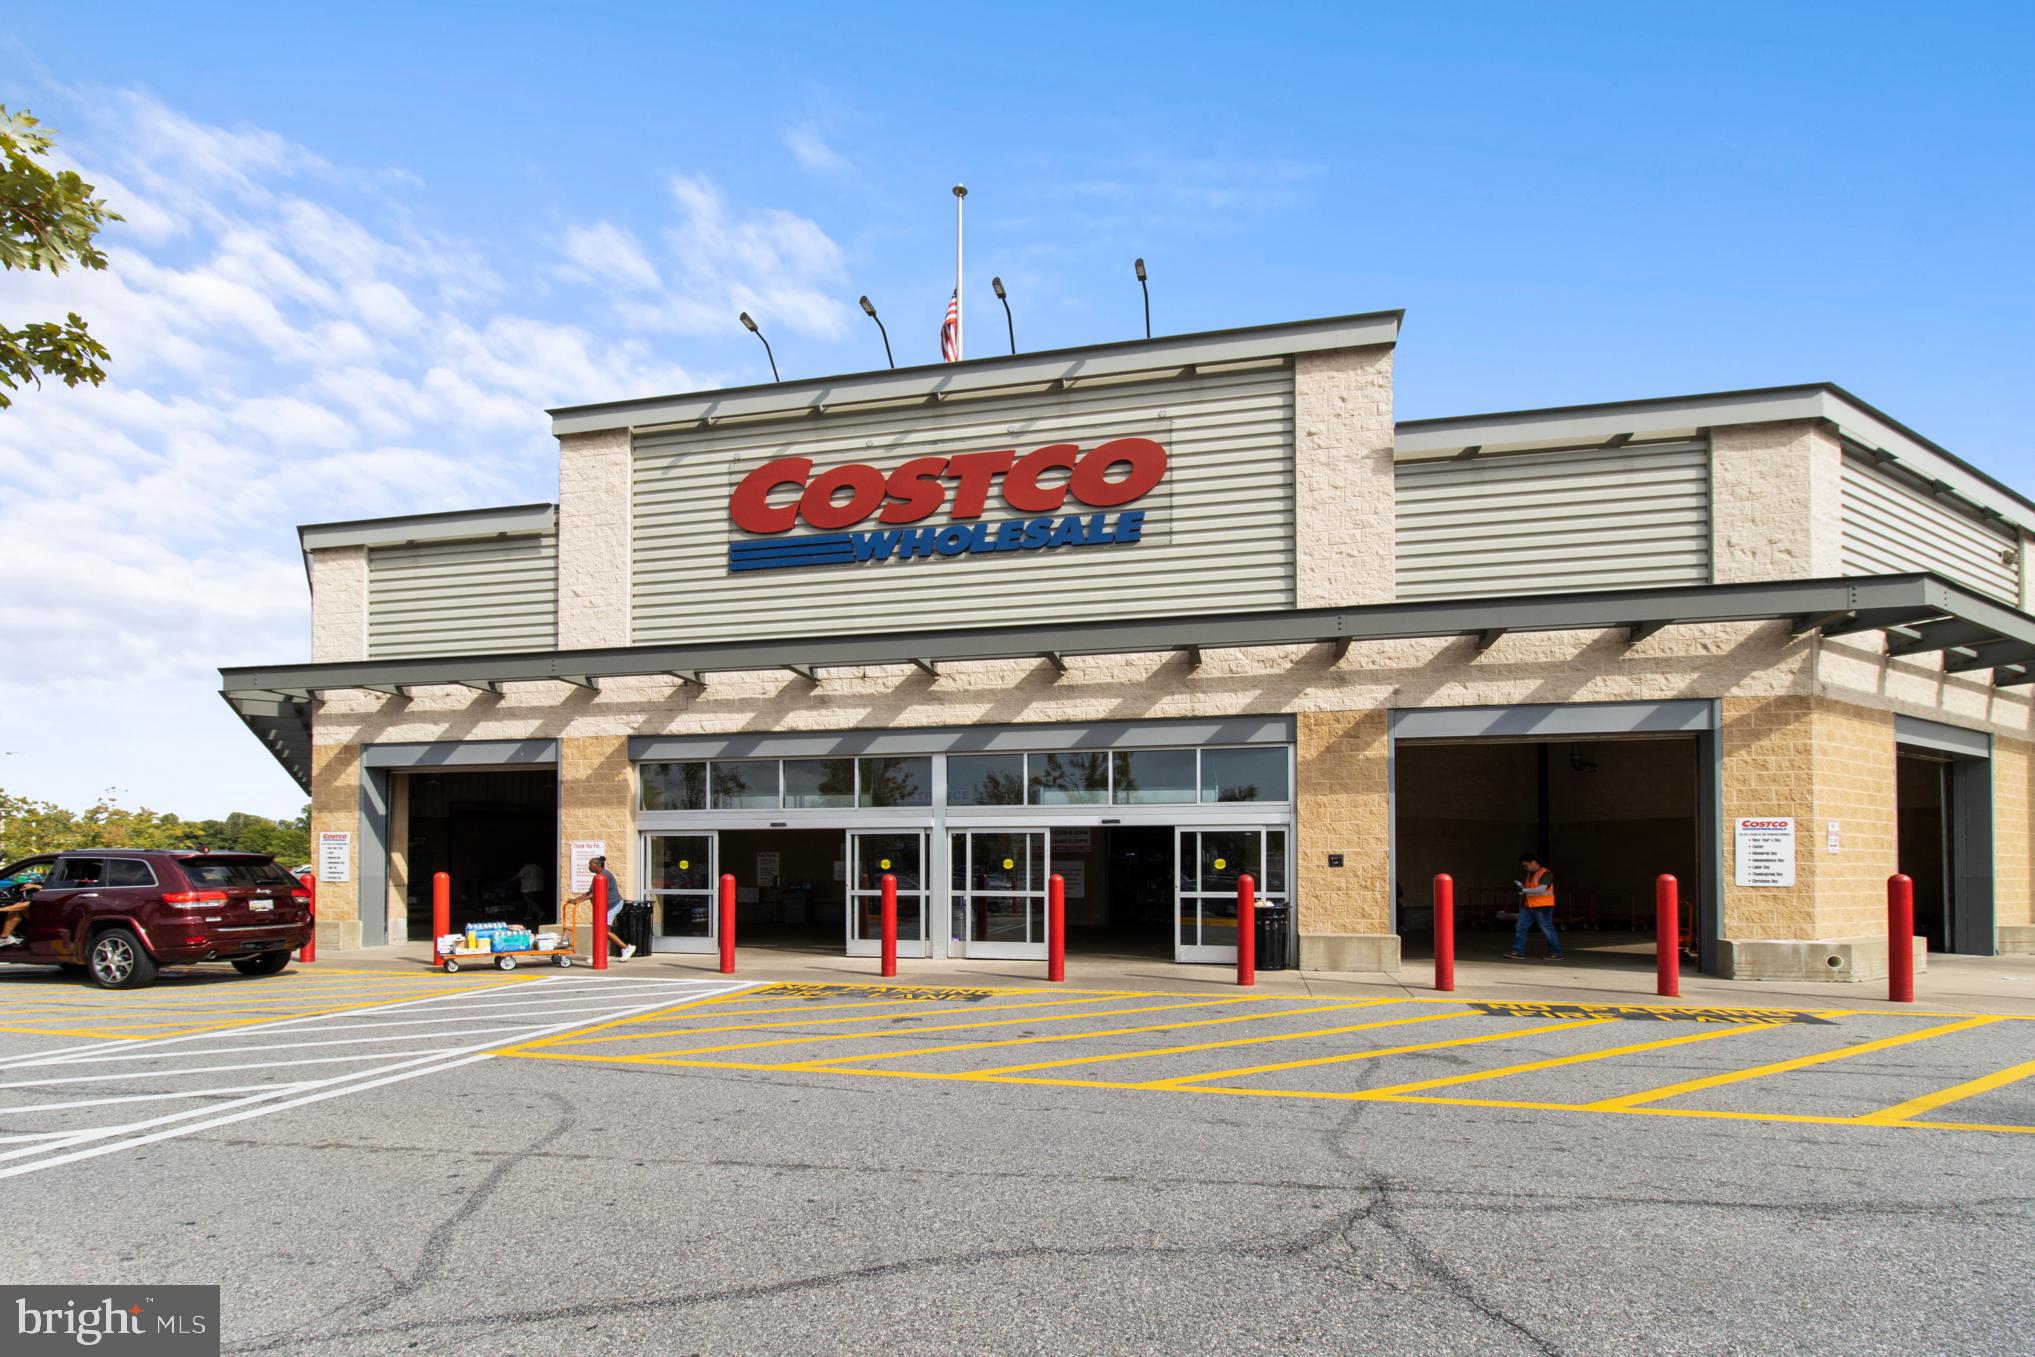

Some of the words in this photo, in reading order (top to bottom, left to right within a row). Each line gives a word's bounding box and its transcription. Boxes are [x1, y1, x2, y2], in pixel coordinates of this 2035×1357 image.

[729, 438, 1168, 535] COSTCO
[850, 511, 1145, 562] WHOLESALE
[1487, 1003, 1552, 1011] NO
[1577, 1006, 1799, 1017] PARKING
[1509, 1011, 1620, 1019] FIRE
[1654, 1014, 1807, 1025] LANE
